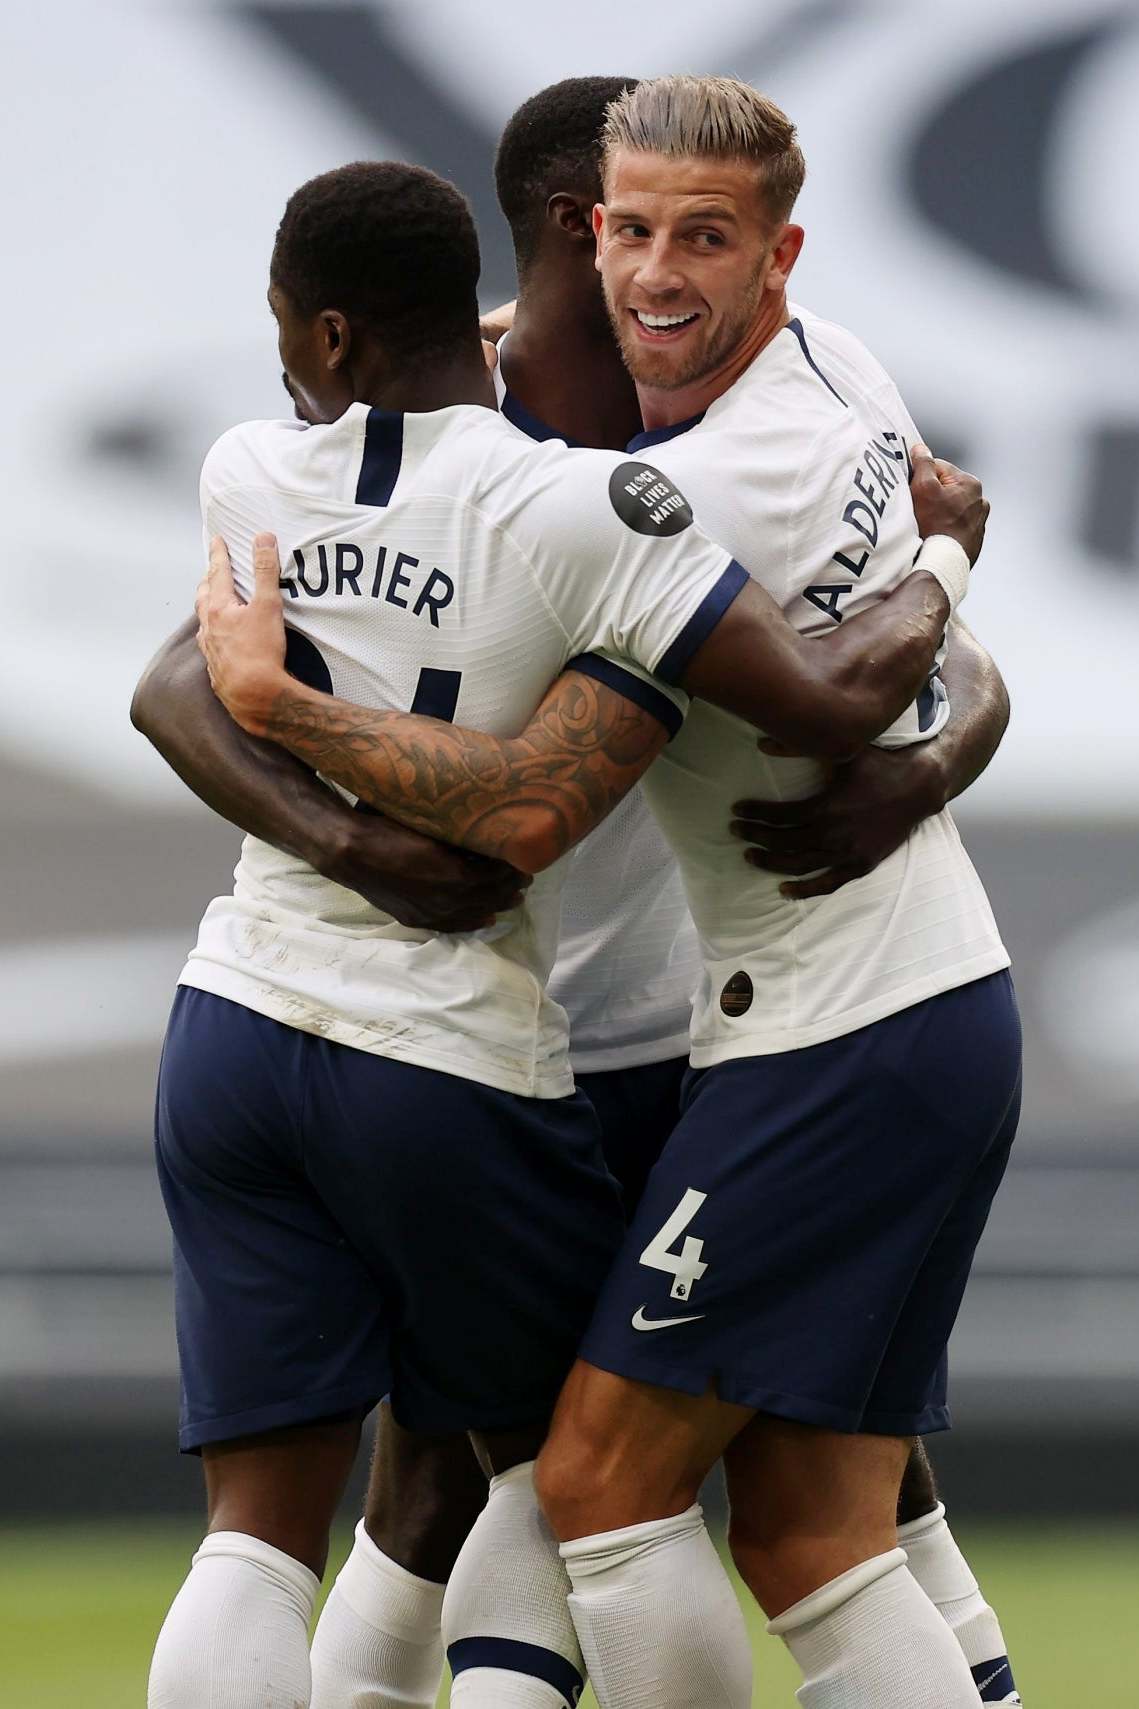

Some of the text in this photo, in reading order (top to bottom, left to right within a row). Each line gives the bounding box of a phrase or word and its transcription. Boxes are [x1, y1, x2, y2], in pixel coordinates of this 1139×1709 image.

[640, 482, 670, 508] LIVES
[649, 494, 686, 525] MATTER
[639, 1187, 709, 1301] 4
